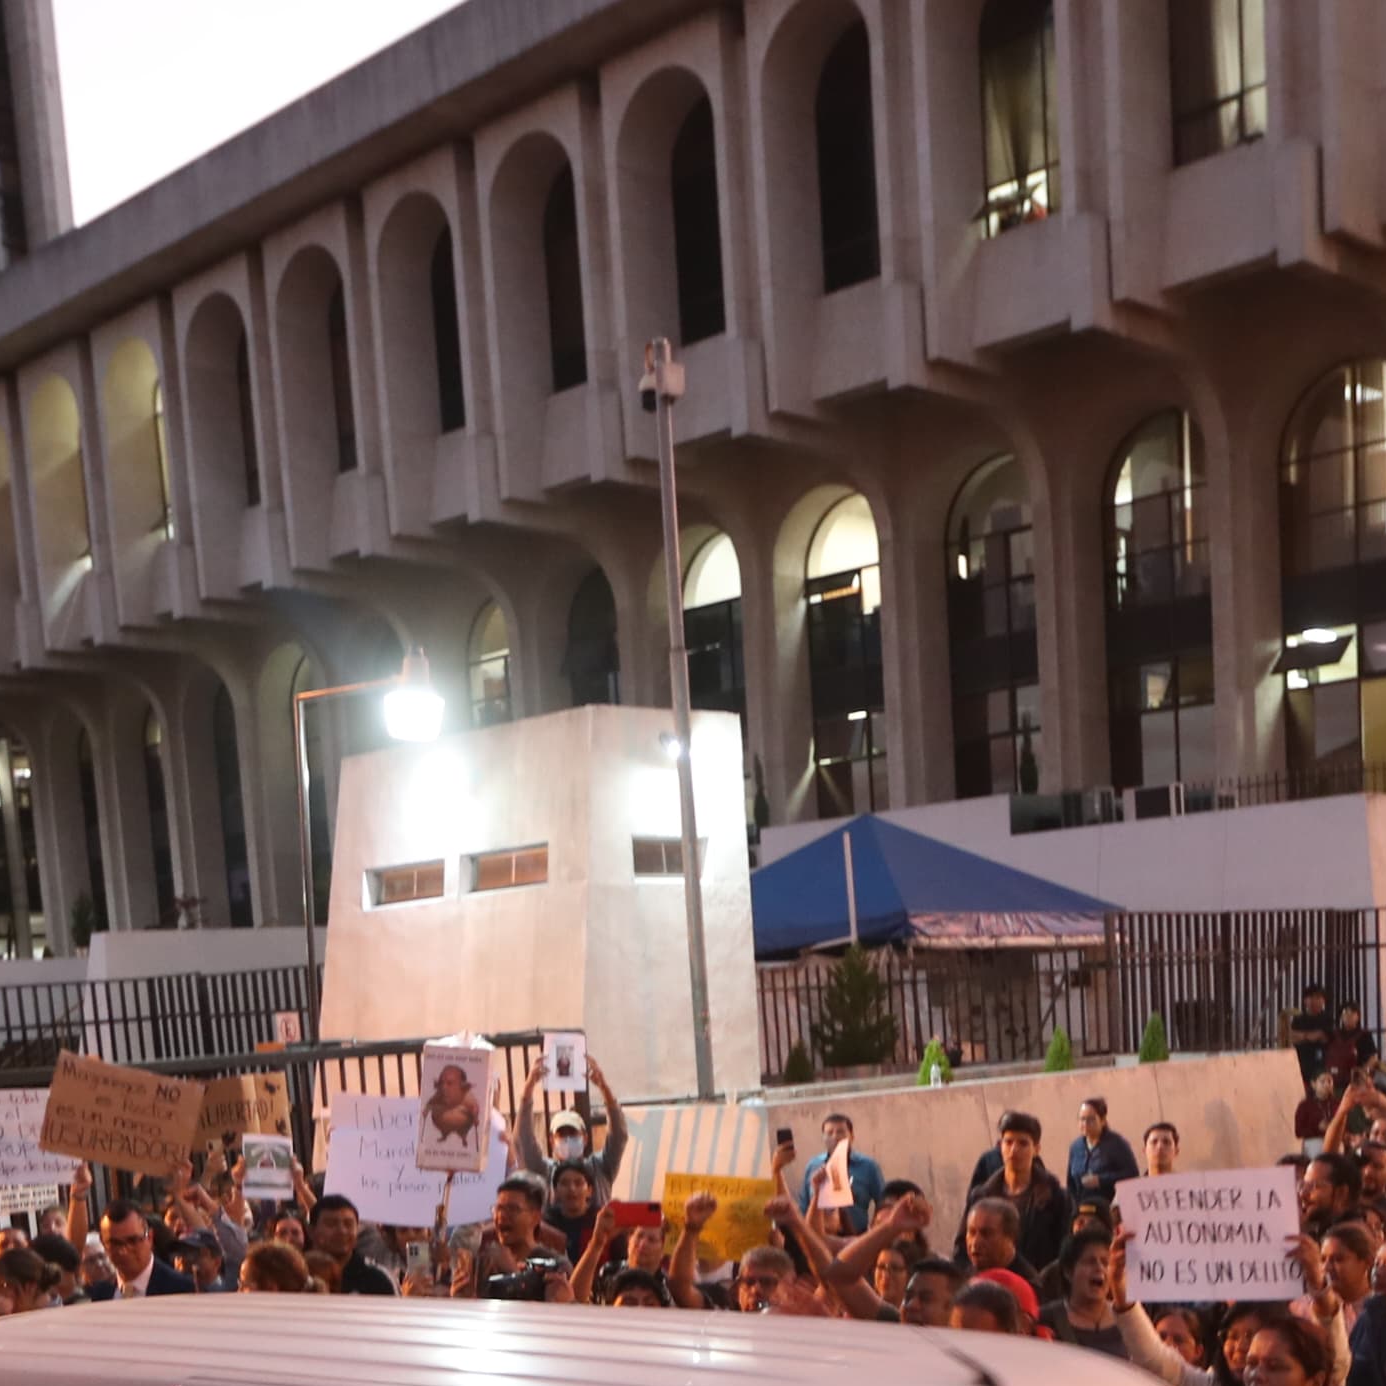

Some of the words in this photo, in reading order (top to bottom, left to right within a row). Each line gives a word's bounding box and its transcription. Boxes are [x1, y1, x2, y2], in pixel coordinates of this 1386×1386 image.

[156, 1083, 182, 1104] NO
[358, 1135, 415, 1160] Marcel
[1136, 1187, 1243, 1212] DEFENDER
[1255, 1188, 1283, 1212] LA
[1143, 1219, 1271, 1246] AUTONOMIA
[1138, 1258, 1165, 1284] NO
[1173, 1258, 1198, 1285] ES
[1205, 1259, 1234, 1285] UN
[1239, 1259, 1304, 1285] DELITO
